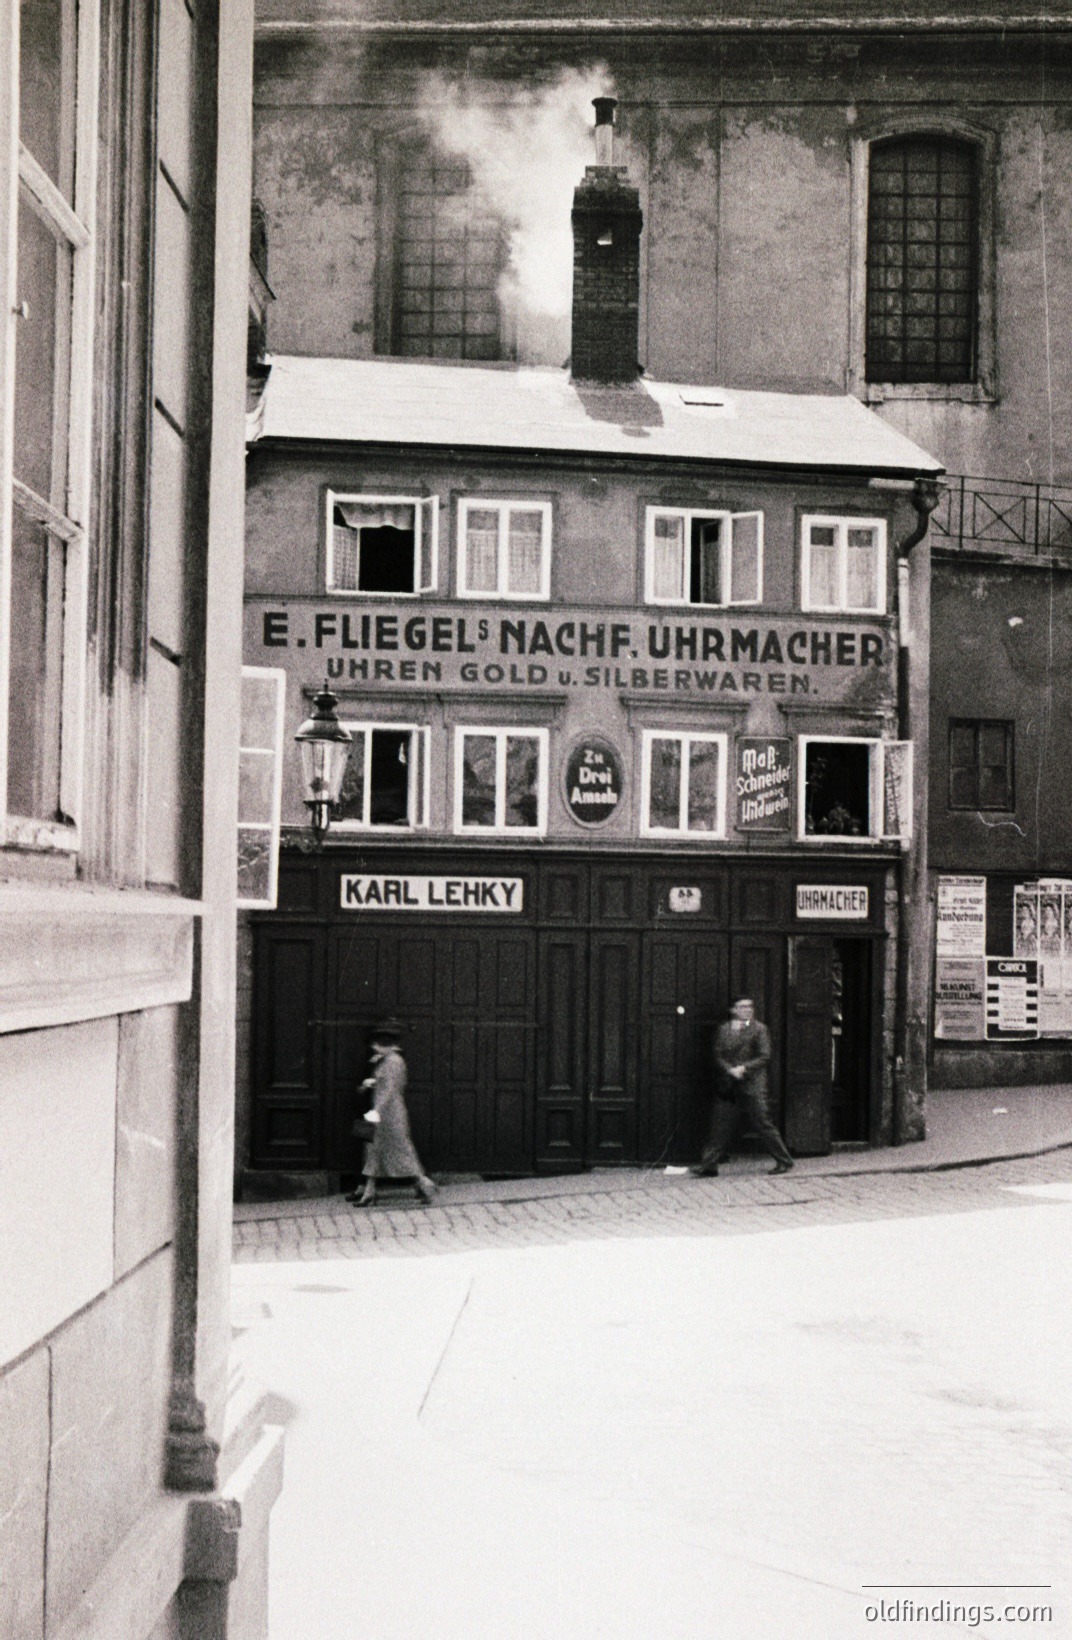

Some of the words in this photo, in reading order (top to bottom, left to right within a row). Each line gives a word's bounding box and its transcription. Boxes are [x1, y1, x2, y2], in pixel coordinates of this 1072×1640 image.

[263, 612, 306, 648] E.
[500, 620, 638, 658] NACHF.
[649, 625, 884, 667] UHRMACHER
[327, 658, 442, 681] UHREN
[460, 663, 548, 685] GOLD
[584, 667, 819, 694] SILBERWAREN.
[579, 767, 612, 784] Drei
[737, 764, 791, 796] Schneider
[346, 879, 419, 905] KARL
[428, 881, 517, 906] LEHKY
[798, 890, 867, 911] UHRMACHER
